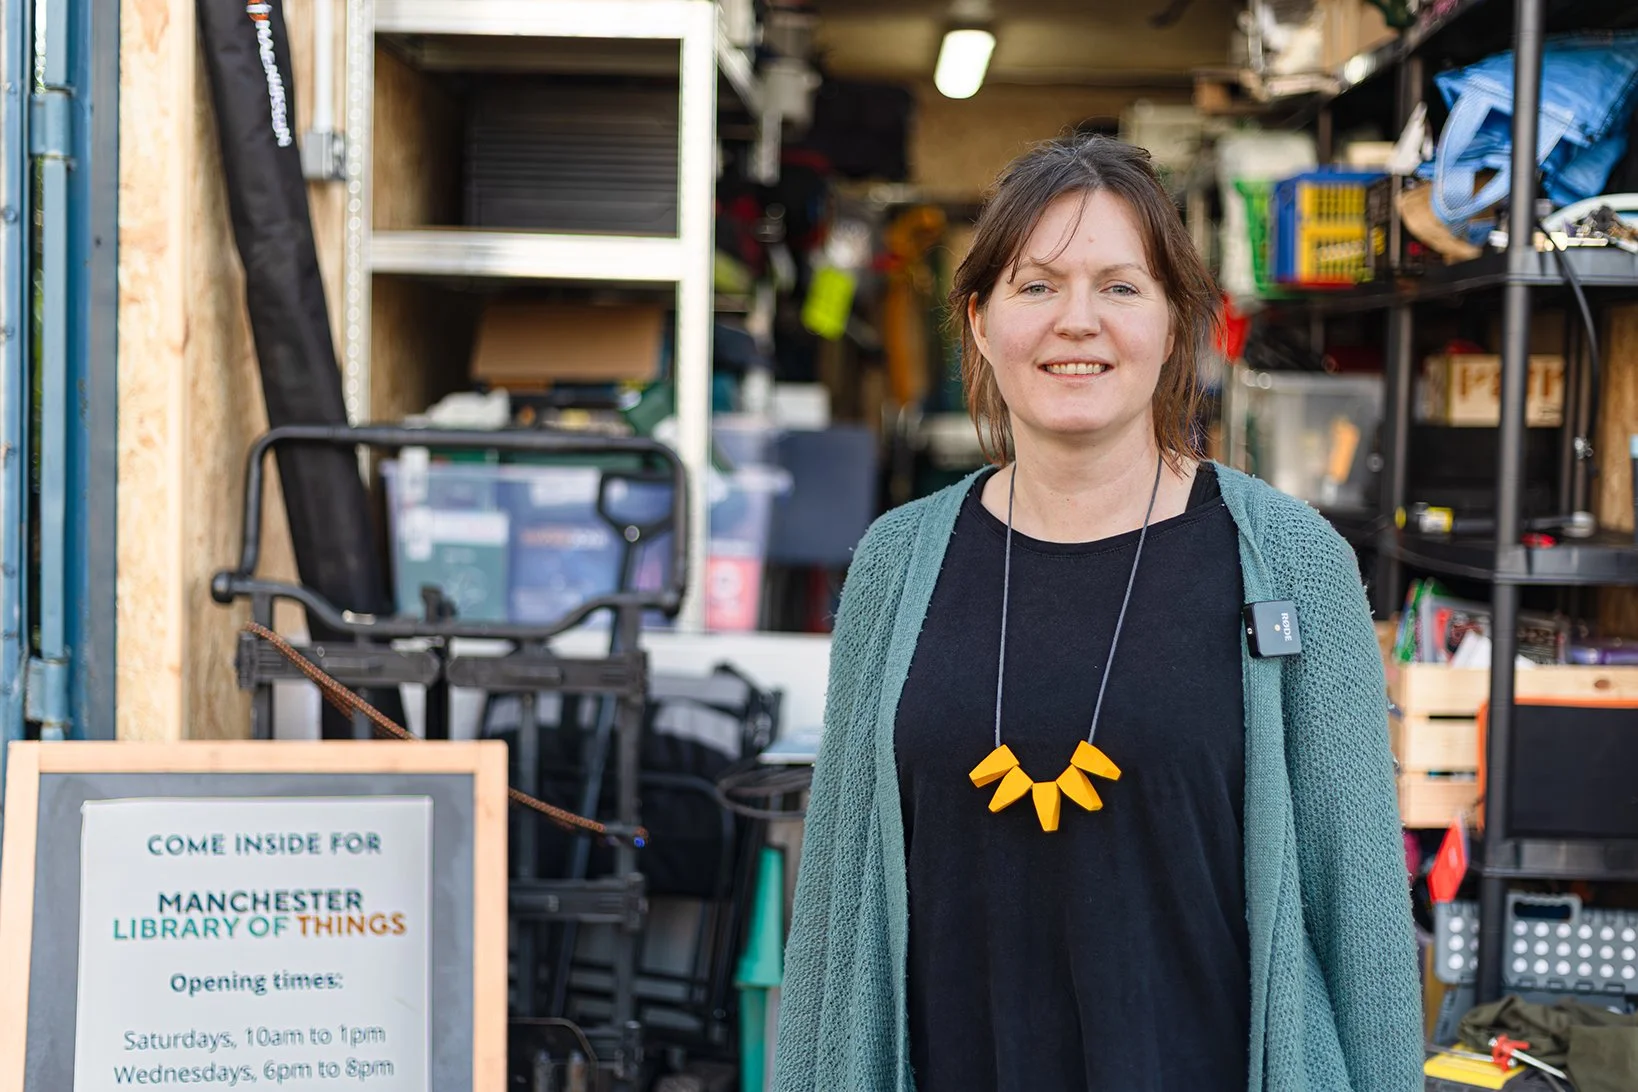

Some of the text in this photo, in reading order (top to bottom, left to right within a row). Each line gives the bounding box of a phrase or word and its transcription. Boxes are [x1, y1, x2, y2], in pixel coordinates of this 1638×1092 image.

[146, 832, 382, 856] COME INSIDE FOR
[157, 889, 364, 914] MANCHESTER
[112, 912, 408, 941] LIBRARY OF THINGS
[169, 969, 344, 998] Opening times:
[123, 1024, 387, 1054] Saturdays, 10am to 1pm
[113, 1058, 395, 1087] Wednesdays, 6pm to 8pm
